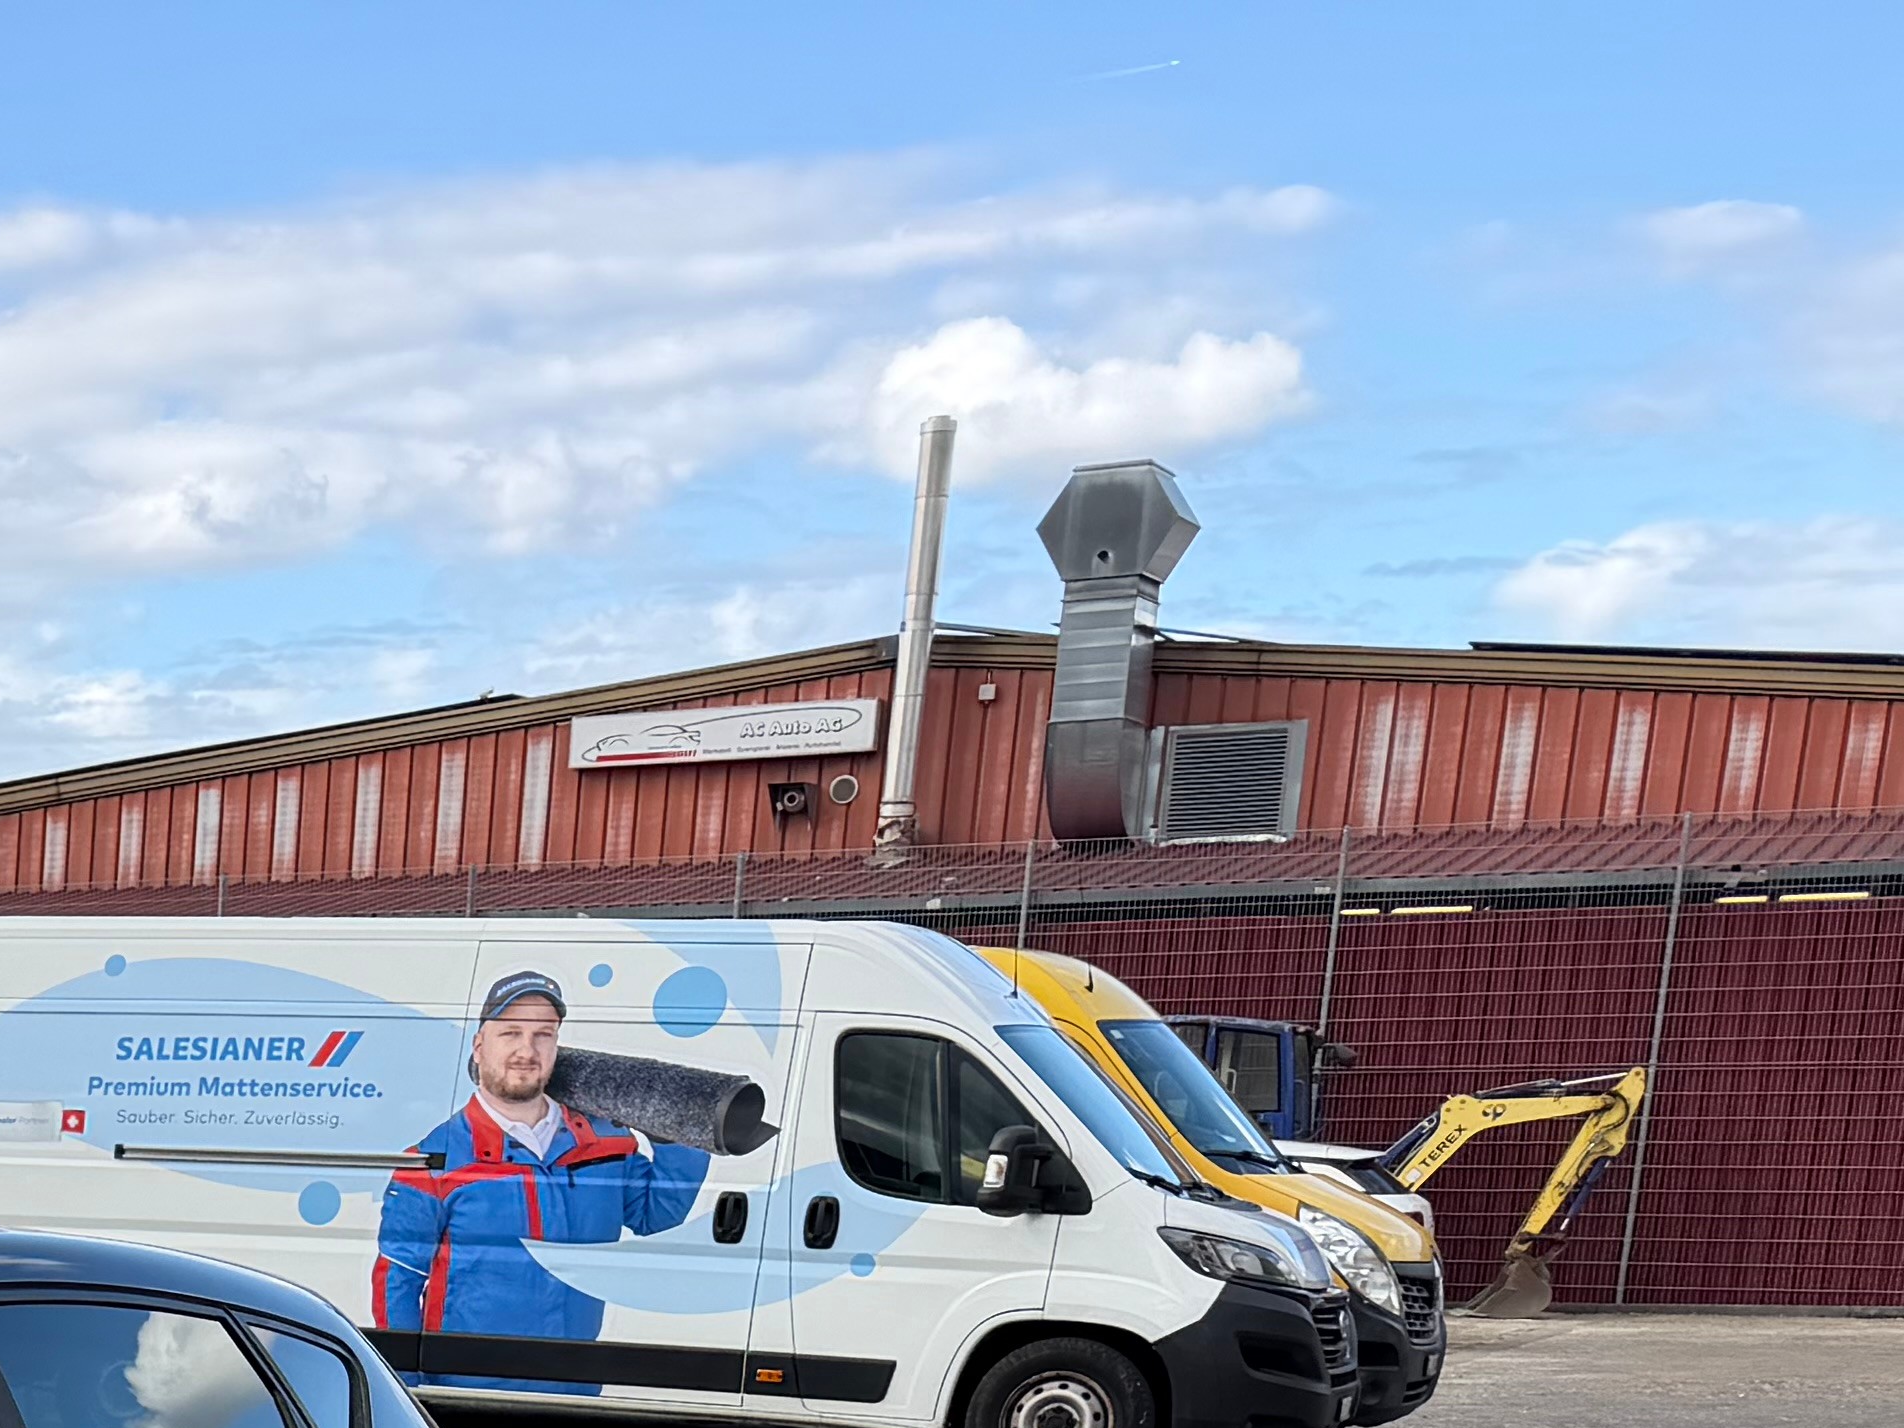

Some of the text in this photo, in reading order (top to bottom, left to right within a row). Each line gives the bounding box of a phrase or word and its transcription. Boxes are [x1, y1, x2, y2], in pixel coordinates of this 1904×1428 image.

[740, 717, 843, 739] AC Auto AG
[116, 1036, 306, 1062] SALESIANER
[87, 1075, 384, 1099] Premium Mattenservice.
[183, 1109, 238, 1126] Sicher.
[244, 1110, 345, 1129] Zuverlässig.
[1418, 1124, 1468, 1168] TEREX
